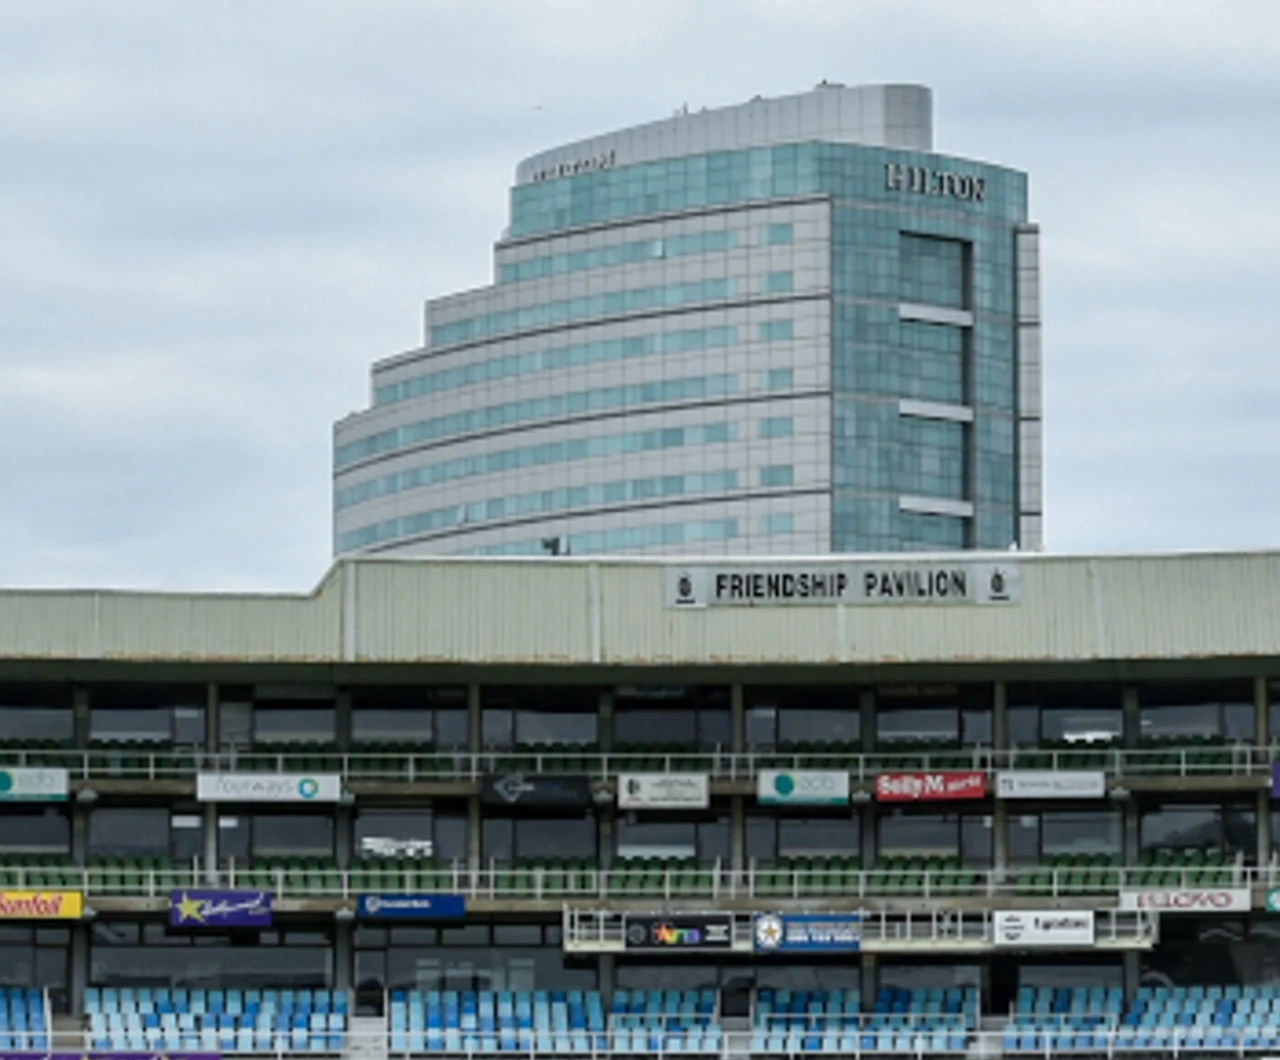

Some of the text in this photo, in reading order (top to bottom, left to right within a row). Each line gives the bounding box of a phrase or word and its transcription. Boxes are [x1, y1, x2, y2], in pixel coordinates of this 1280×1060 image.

[885, 163, 986, 203] HILTON
[715, 570, 967, 599] FRIENDSHIP PAVILION
